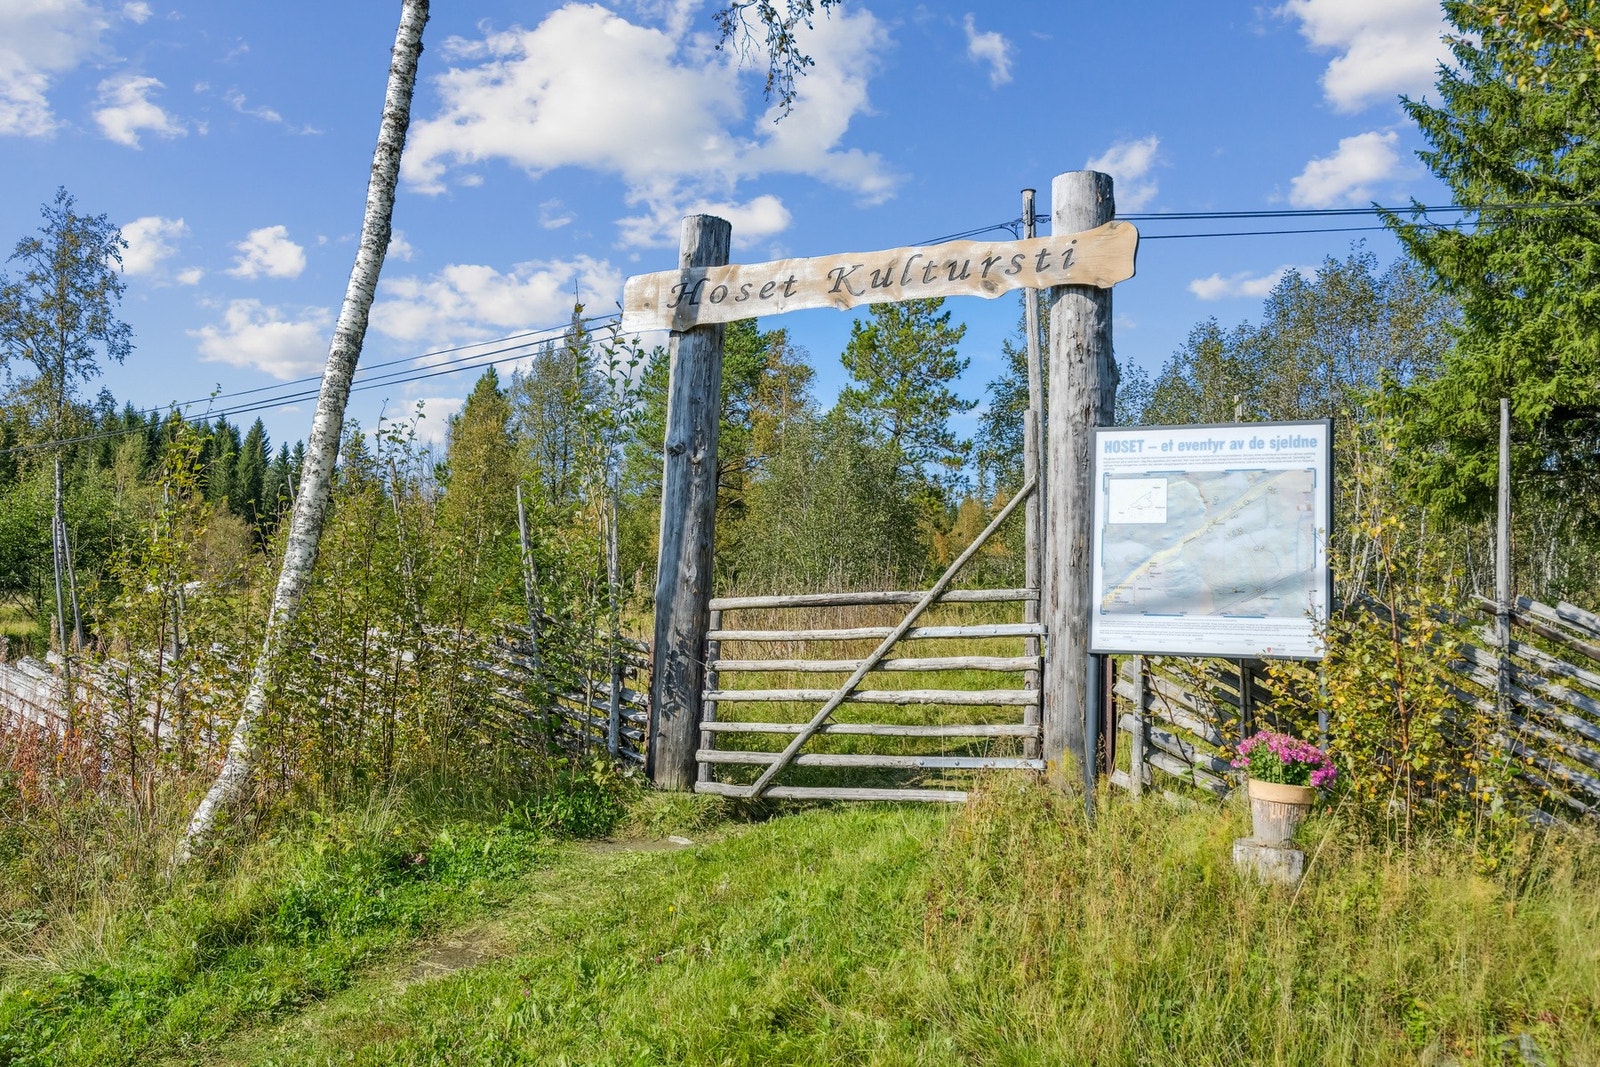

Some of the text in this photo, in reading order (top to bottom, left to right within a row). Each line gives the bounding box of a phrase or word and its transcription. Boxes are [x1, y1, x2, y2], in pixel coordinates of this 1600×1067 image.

[666, 240, 1079, 309] Hoset Kultursti
[1104, 439, 1144, 453] HOSET
[1161, 439, 1175, 452] et
[1178, 438, 1225, 453] eventyr
[1230, 439, 1245, 450] av
[1249, 436, 1264, 449] de
[1269, 434, 1317, 452] sjeldne
